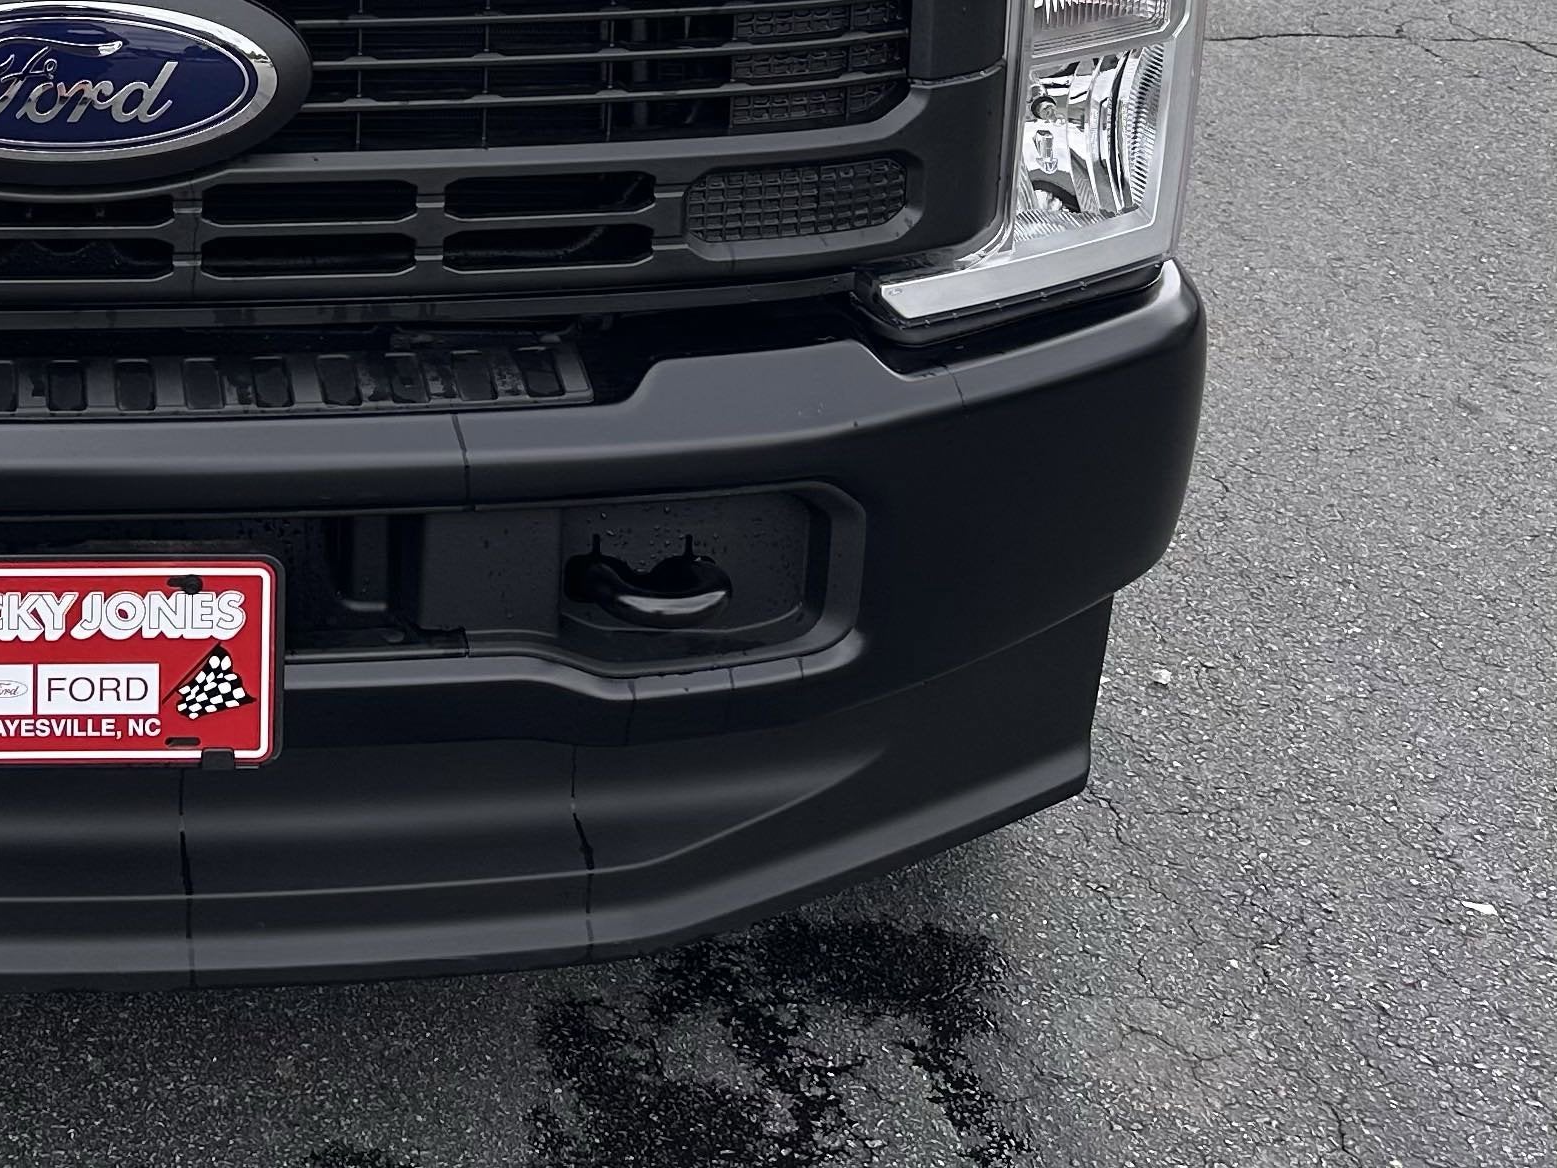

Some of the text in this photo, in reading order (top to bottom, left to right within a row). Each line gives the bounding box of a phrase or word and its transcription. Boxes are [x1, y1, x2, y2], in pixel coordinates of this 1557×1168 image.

[70, 589, 247, 641] JONES
[47, 677, 149, 703] FORD
[132, 717, 162, 738] NC
